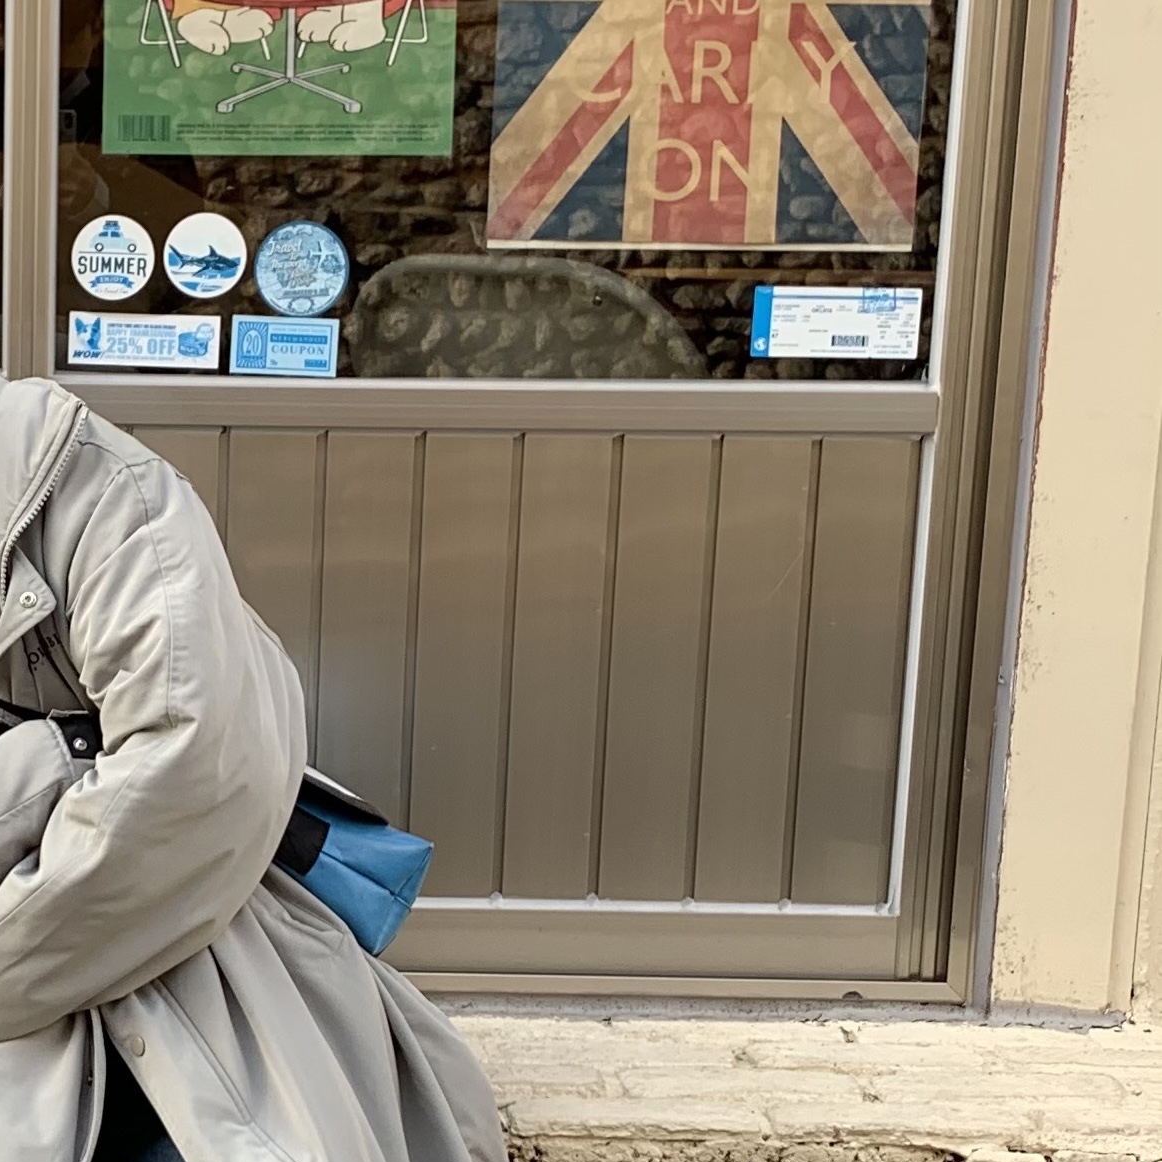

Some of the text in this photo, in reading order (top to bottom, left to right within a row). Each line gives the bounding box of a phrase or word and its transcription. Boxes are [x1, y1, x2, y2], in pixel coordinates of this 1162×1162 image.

[666, 0, 760, 16] AND
[569, 40, 856, 104] CARY
[641, 138, 763, 202] ON
[77, 255, 147, 277] SUMMER
[105, 337, 177, 355] 25% OFF
[245, 333, 260, 354] 20
[271, 345, 325, 355] COUPON
